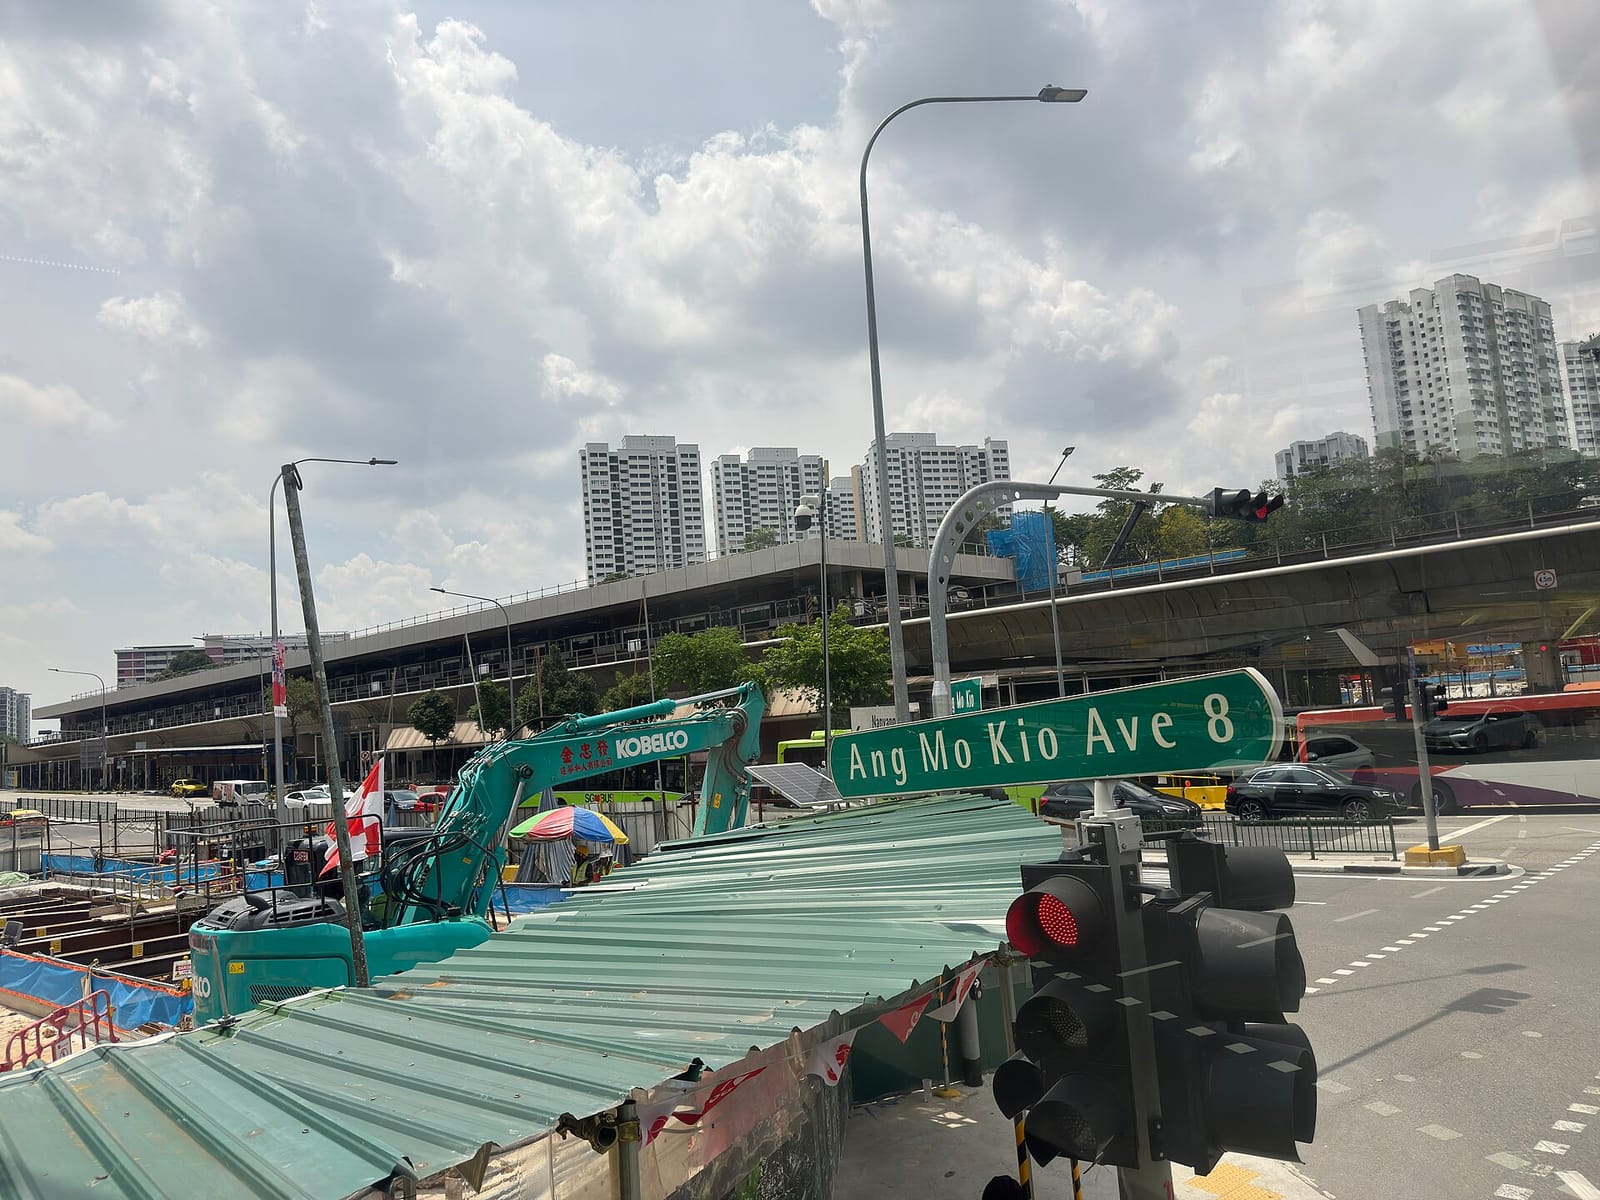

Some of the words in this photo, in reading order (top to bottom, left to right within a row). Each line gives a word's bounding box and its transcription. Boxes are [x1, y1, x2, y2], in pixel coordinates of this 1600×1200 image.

[615, 730, 689, 759] KOBELCO
[850, 743, 907, 787] Ang
[918, 730, 972, 772] Mo
[987, 719, 1058, 765] Kio
[1086, 707, 1176, 756] Ave
[1203, 693, 1234, 743] 8
